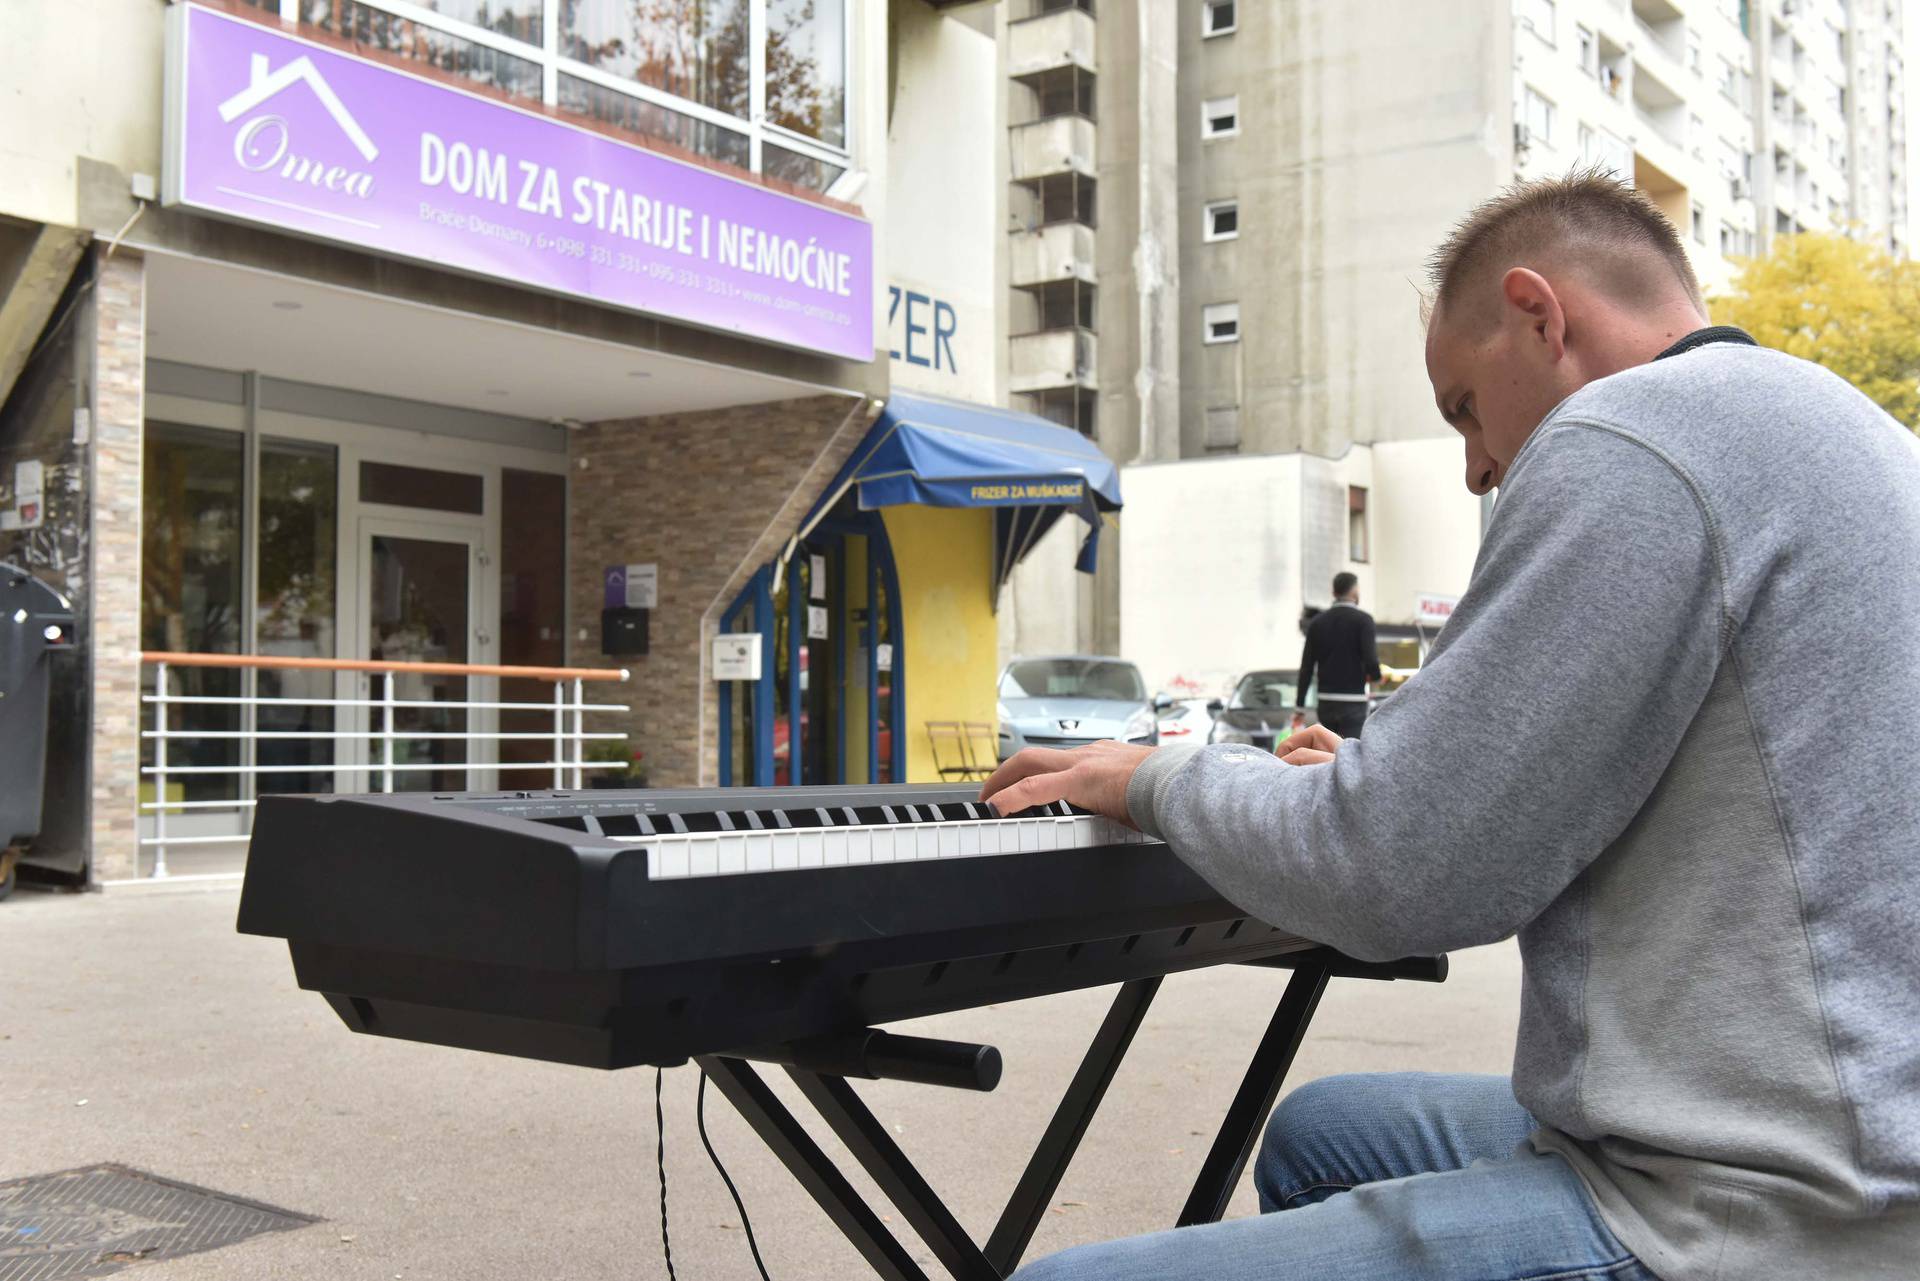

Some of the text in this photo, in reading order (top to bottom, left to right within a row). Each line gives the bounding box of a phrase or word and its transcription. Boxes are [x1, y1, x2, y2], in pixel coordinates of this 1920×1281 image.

[233, 114, 374, 198] Omea
[420, 131, 851, 297] DOM ZA STARIJE I NEMOĆNE
[971, 486, 1009, 499] FRIZER
[1011, 486, 1025, 498] ZA
